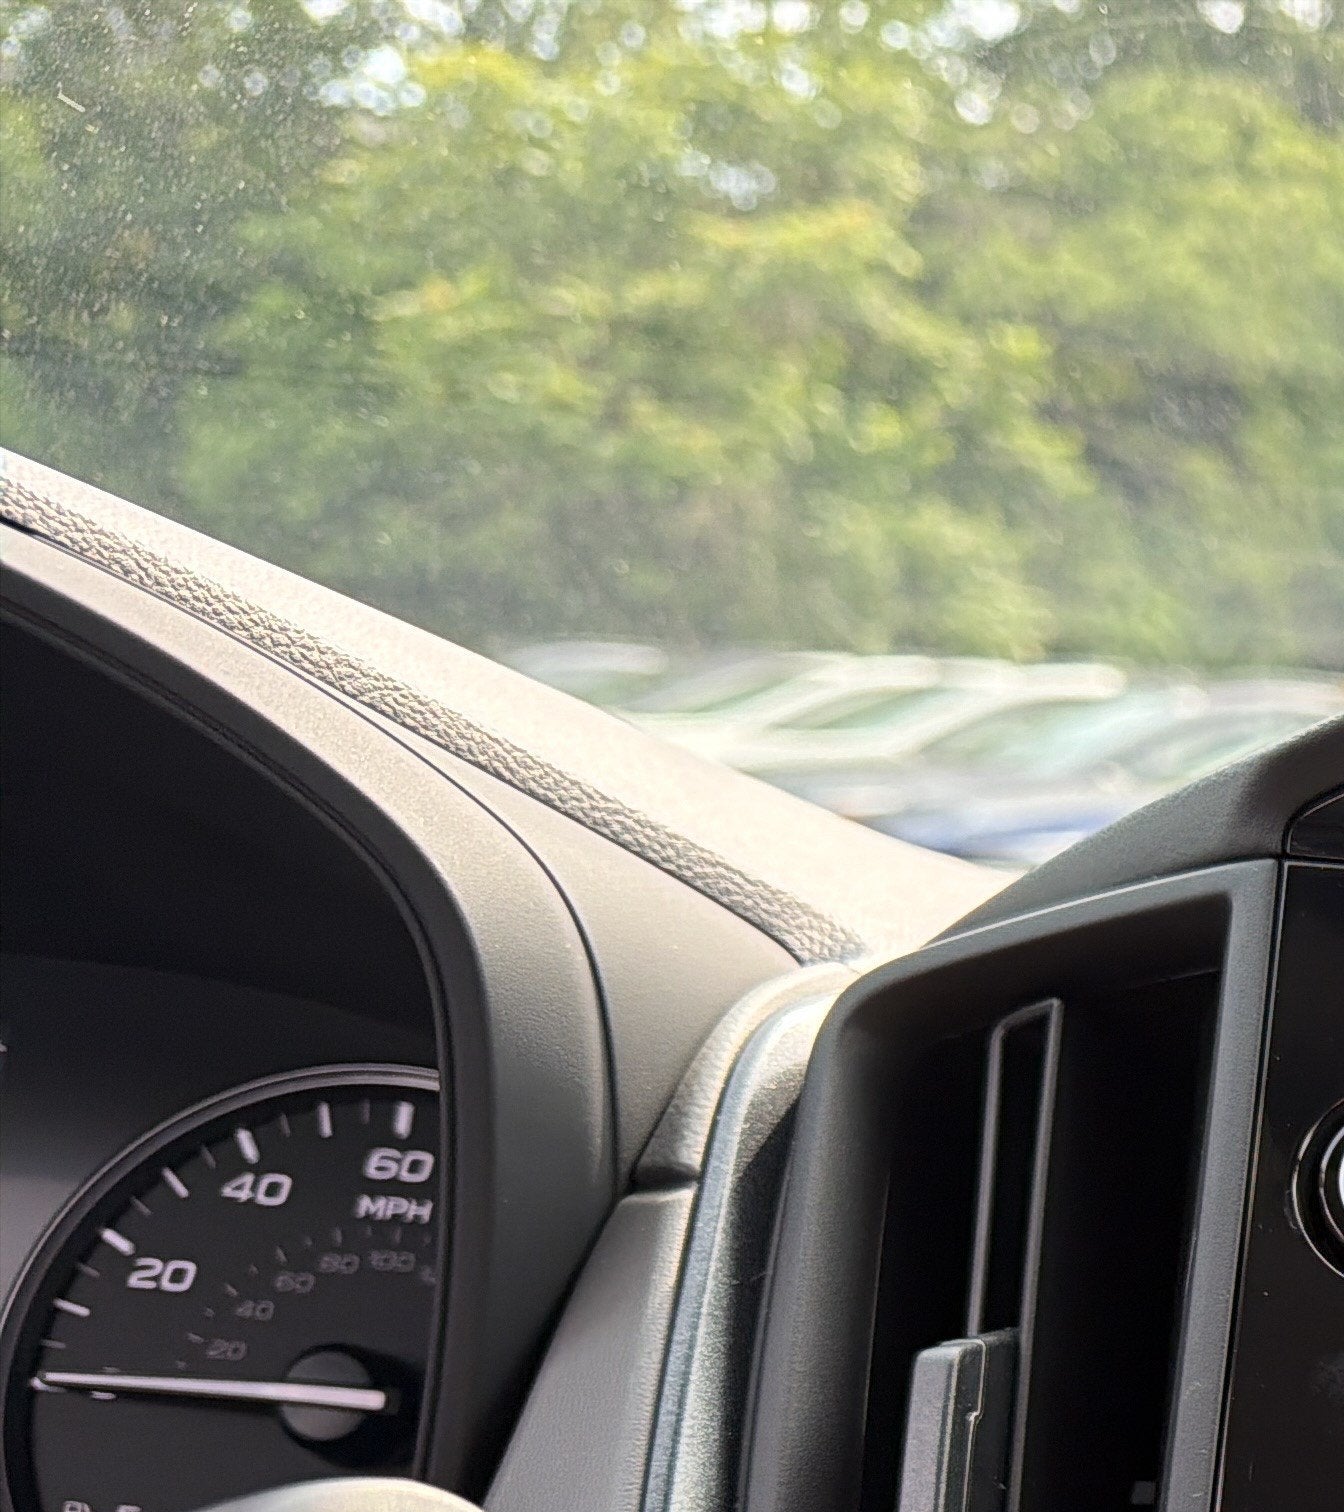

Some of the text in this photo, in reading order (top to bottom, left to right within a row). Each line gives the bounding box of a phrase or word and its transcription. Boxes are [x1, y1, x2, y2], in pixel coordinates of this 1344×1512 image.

[364, 1148, 434, 1184] 60
[220, 1172, 293, 1207] 40
[355, 1194, 433, 1223] MPH
[127, 1258, 197, 1293] 20
